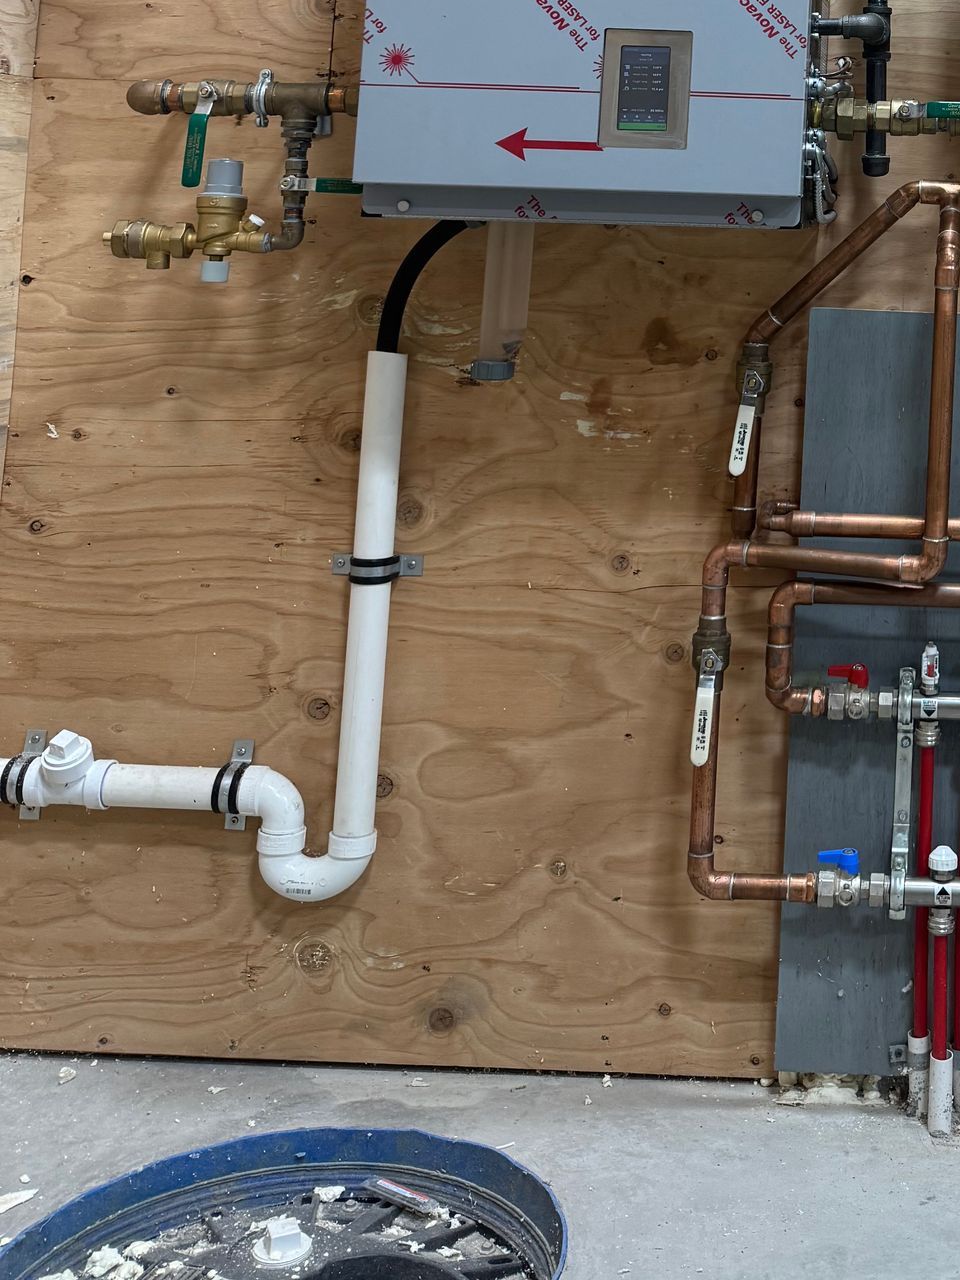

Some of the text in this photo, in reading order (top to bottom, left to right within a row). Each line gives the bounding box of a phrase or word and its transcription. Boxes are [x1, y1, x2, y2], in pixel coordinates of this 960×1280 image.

[370, 18, 388, 33] for
[766, 3, 798, 35] LASER
[569, 28, 588, 52] The
[585, 25, 601, 41] for
[779, 36, 799, 60] The
[527, 194, 546, 218] The
[724, 211, 738, 225] fo
[736, 201, 754, 225] The
